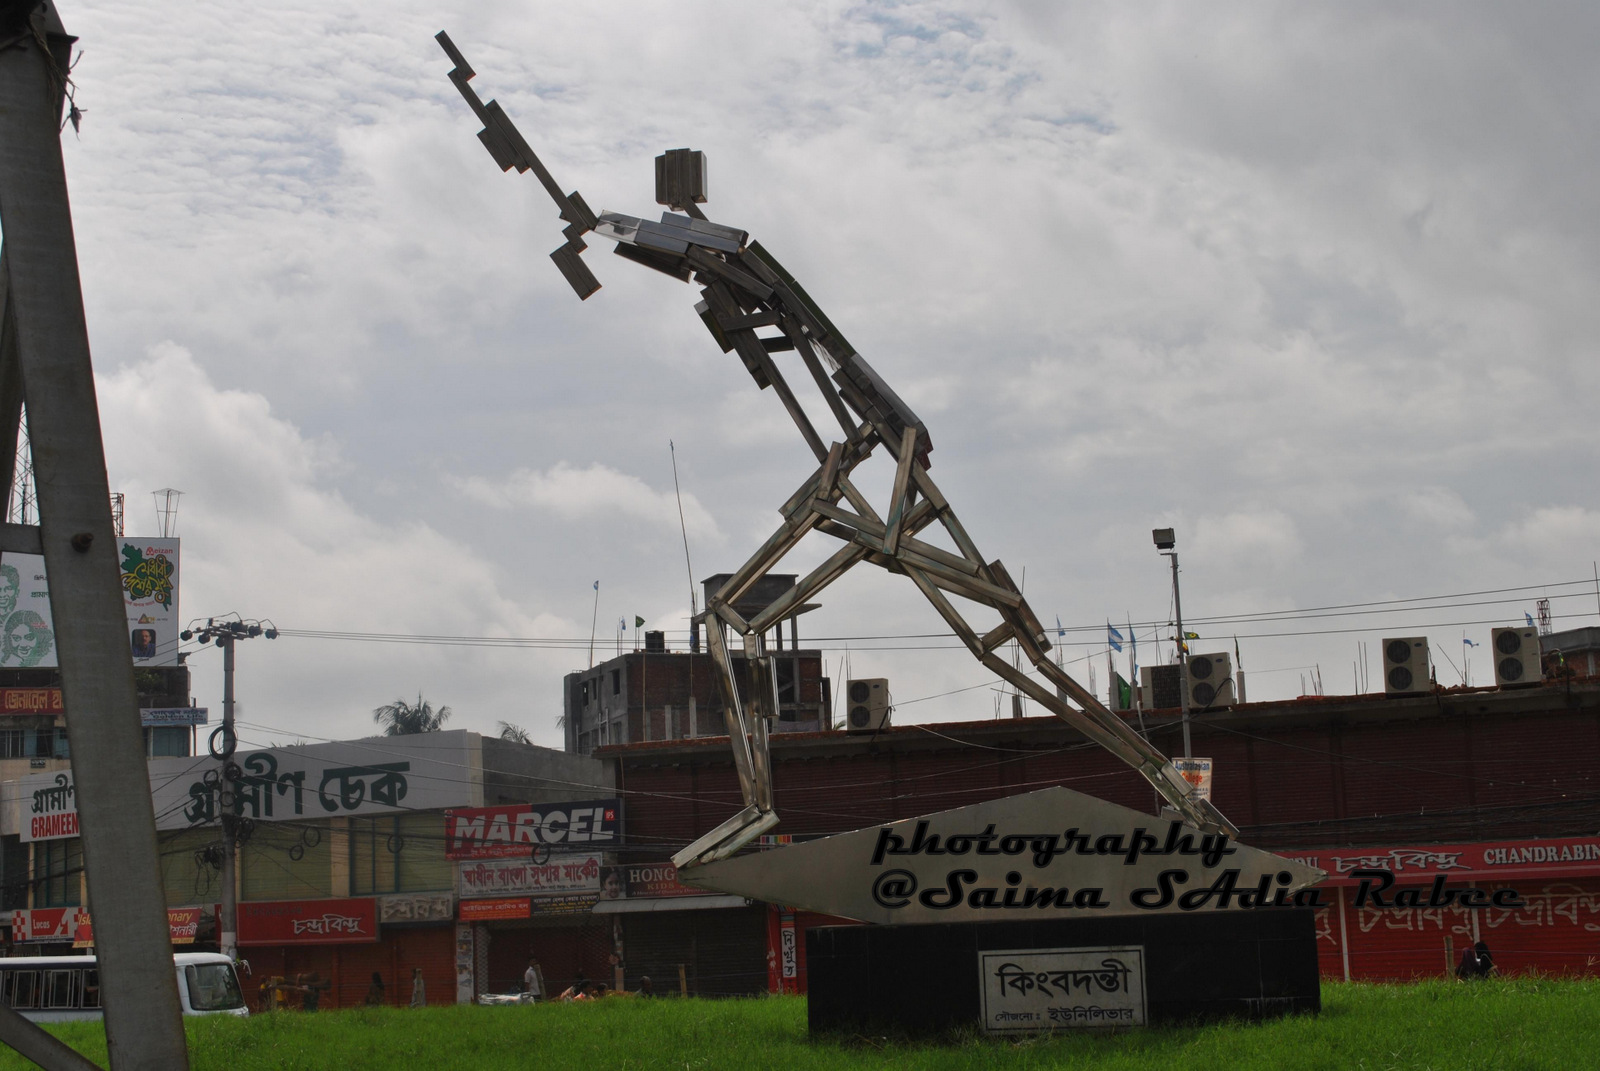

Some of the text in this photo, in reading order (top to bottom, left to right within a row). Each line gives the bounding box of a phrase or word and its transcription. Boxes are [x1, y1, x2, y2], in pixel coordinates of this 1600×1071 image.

[184, 752, 411, 824] গ্রমীণ চেক
[31, 811, 79, 839] GRAMEEN
[453, 807, 614, 848] MARCEL
[1331, 848, 1473, 873] চন্দ্রবিন্দু
[497, 865, 528, 886] বাংলা
[647, 882, 676, 890] KIDS
[32, 918, 50, 930] Lucas
[291, 913, 367, 935] চন্দ্রবিন্দু
[994, 957, 1134, 998] কিংবদন্তী
[1047, 1005, 1135, 1023] ইউনিলিভার
